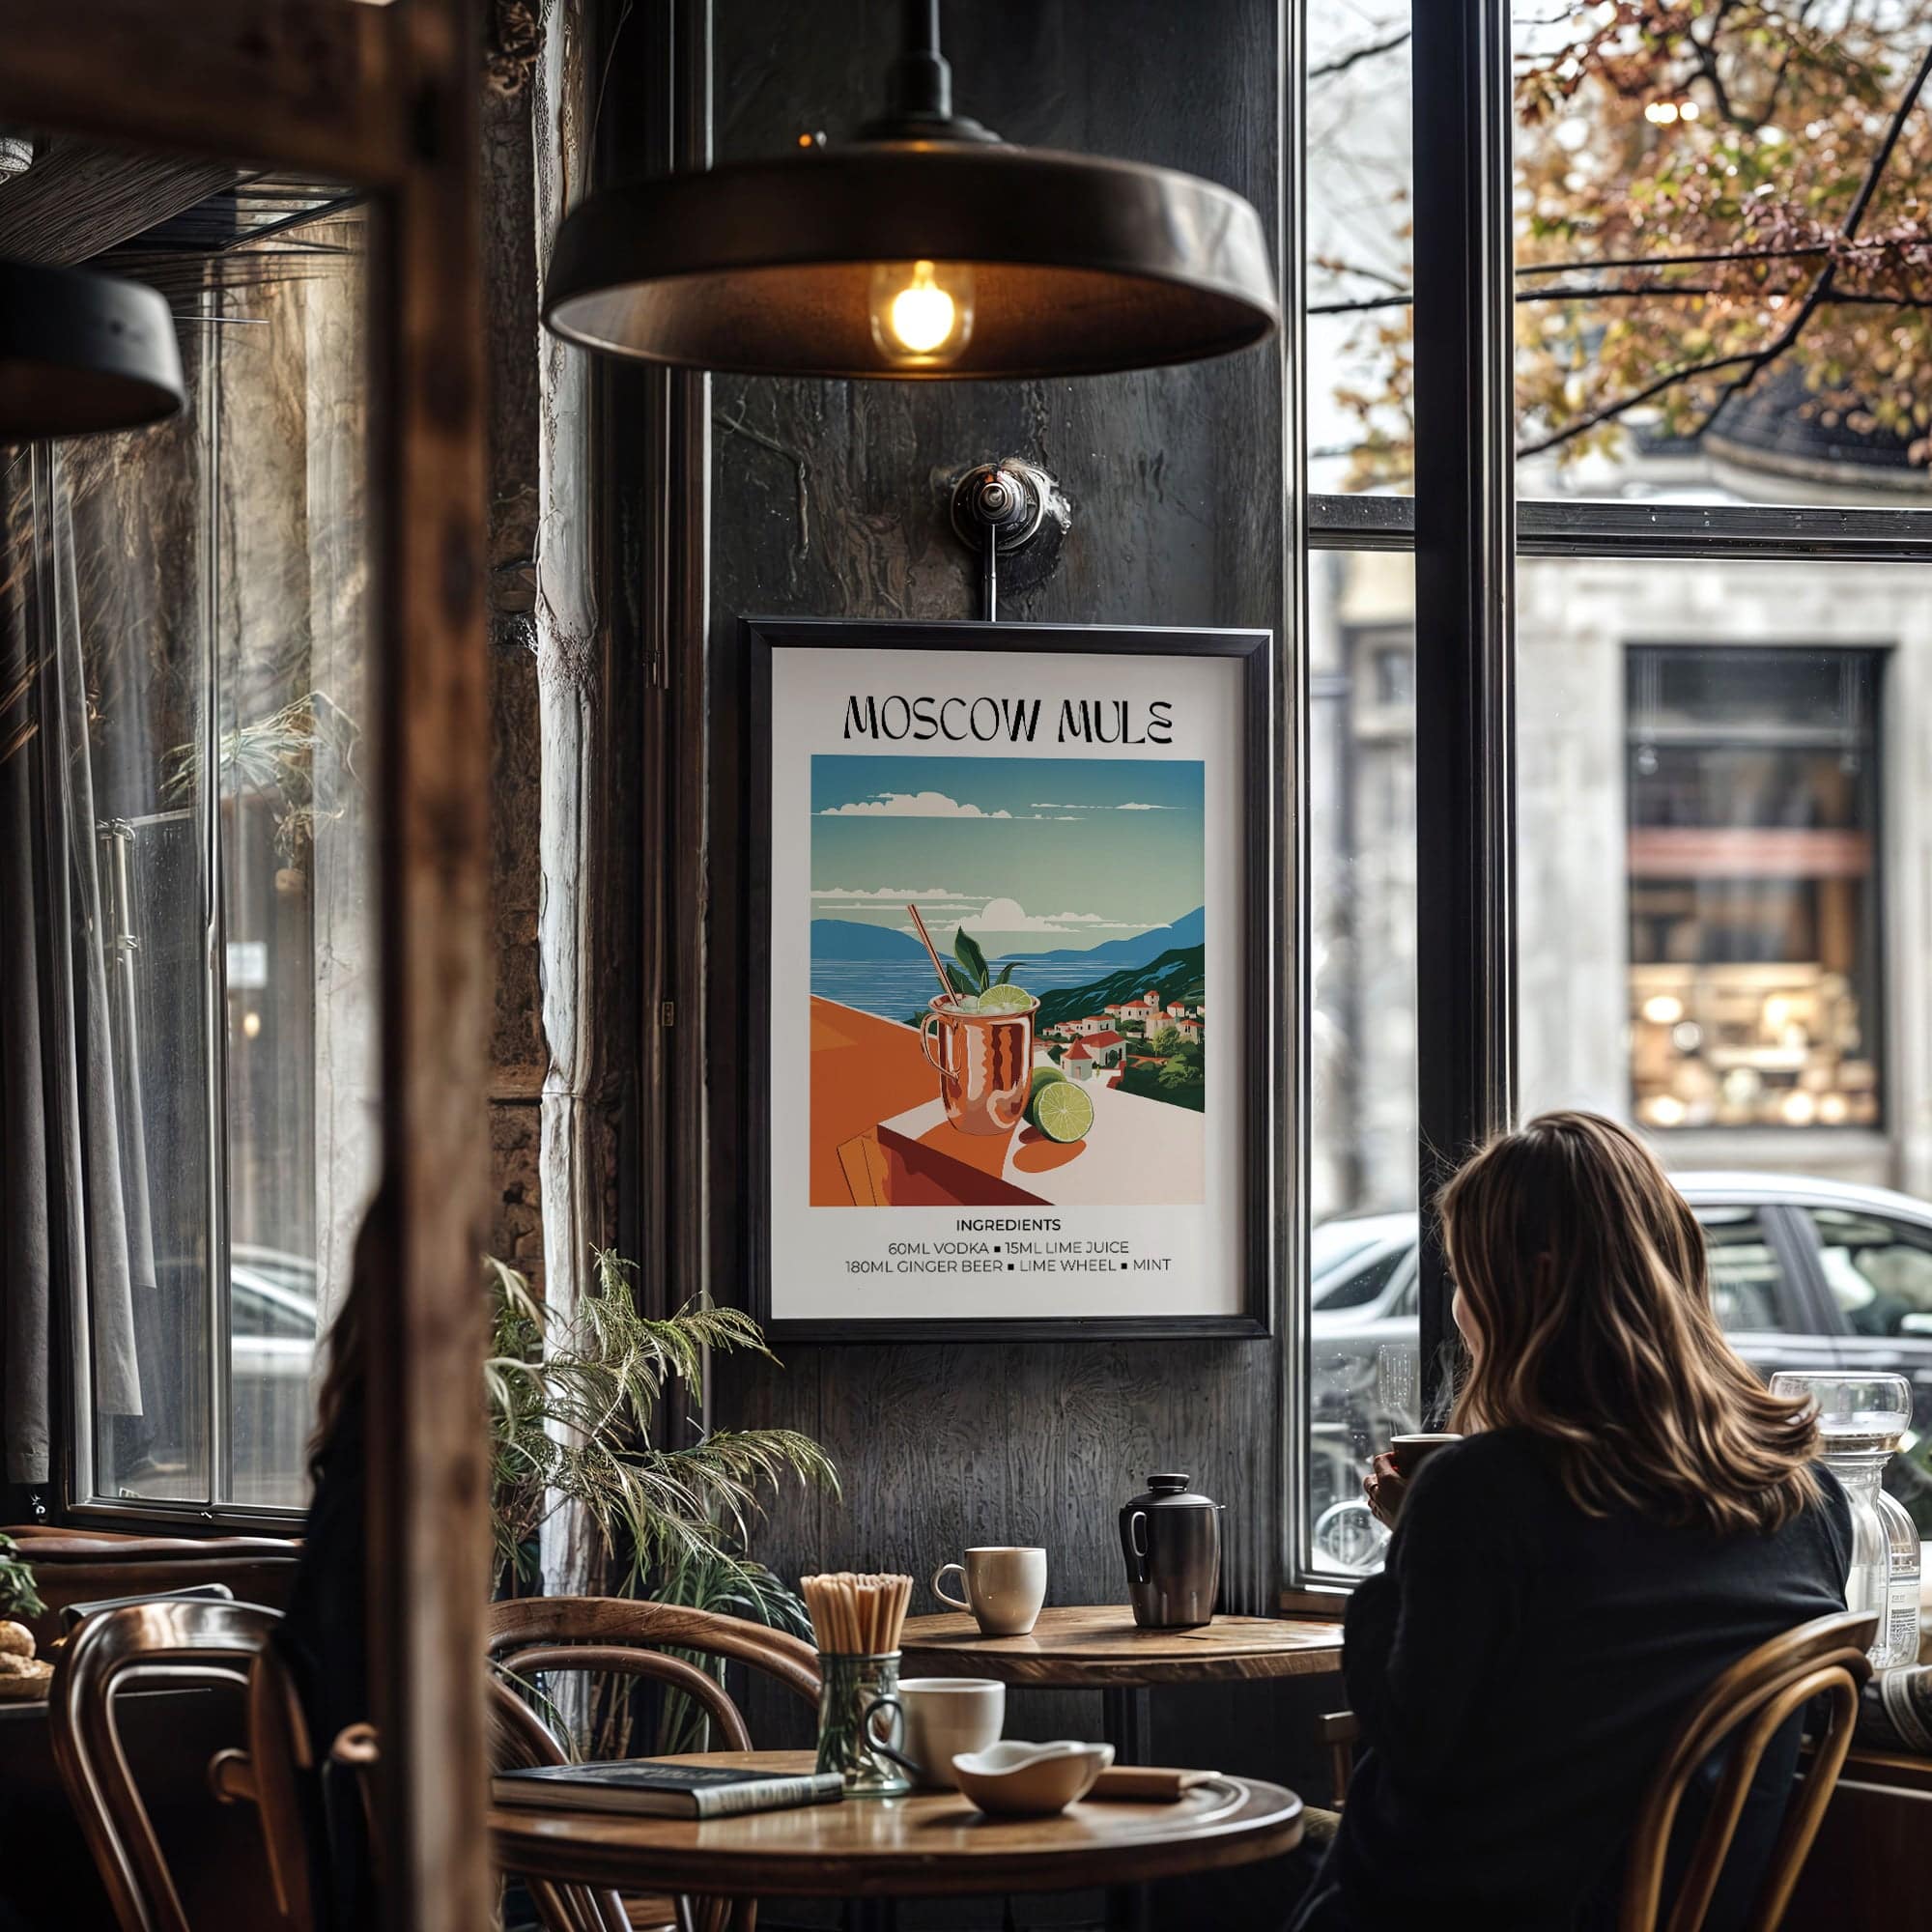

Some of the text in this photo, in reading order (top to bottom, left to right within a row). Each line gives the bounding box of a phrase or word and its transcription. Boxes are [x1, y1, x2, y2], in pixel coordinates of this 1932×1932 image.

[844, 696, 1173, 744] MOSCOW MULE
[956, 1219, 1061, 1232] INGREDIENTS
[889, 1241, 1128, 1255] 60ML VODKA 15ML LIME JUICE
[845, 1259, 1172, 1273] 180ML GINGER BEER LIME WHEEL MINT
